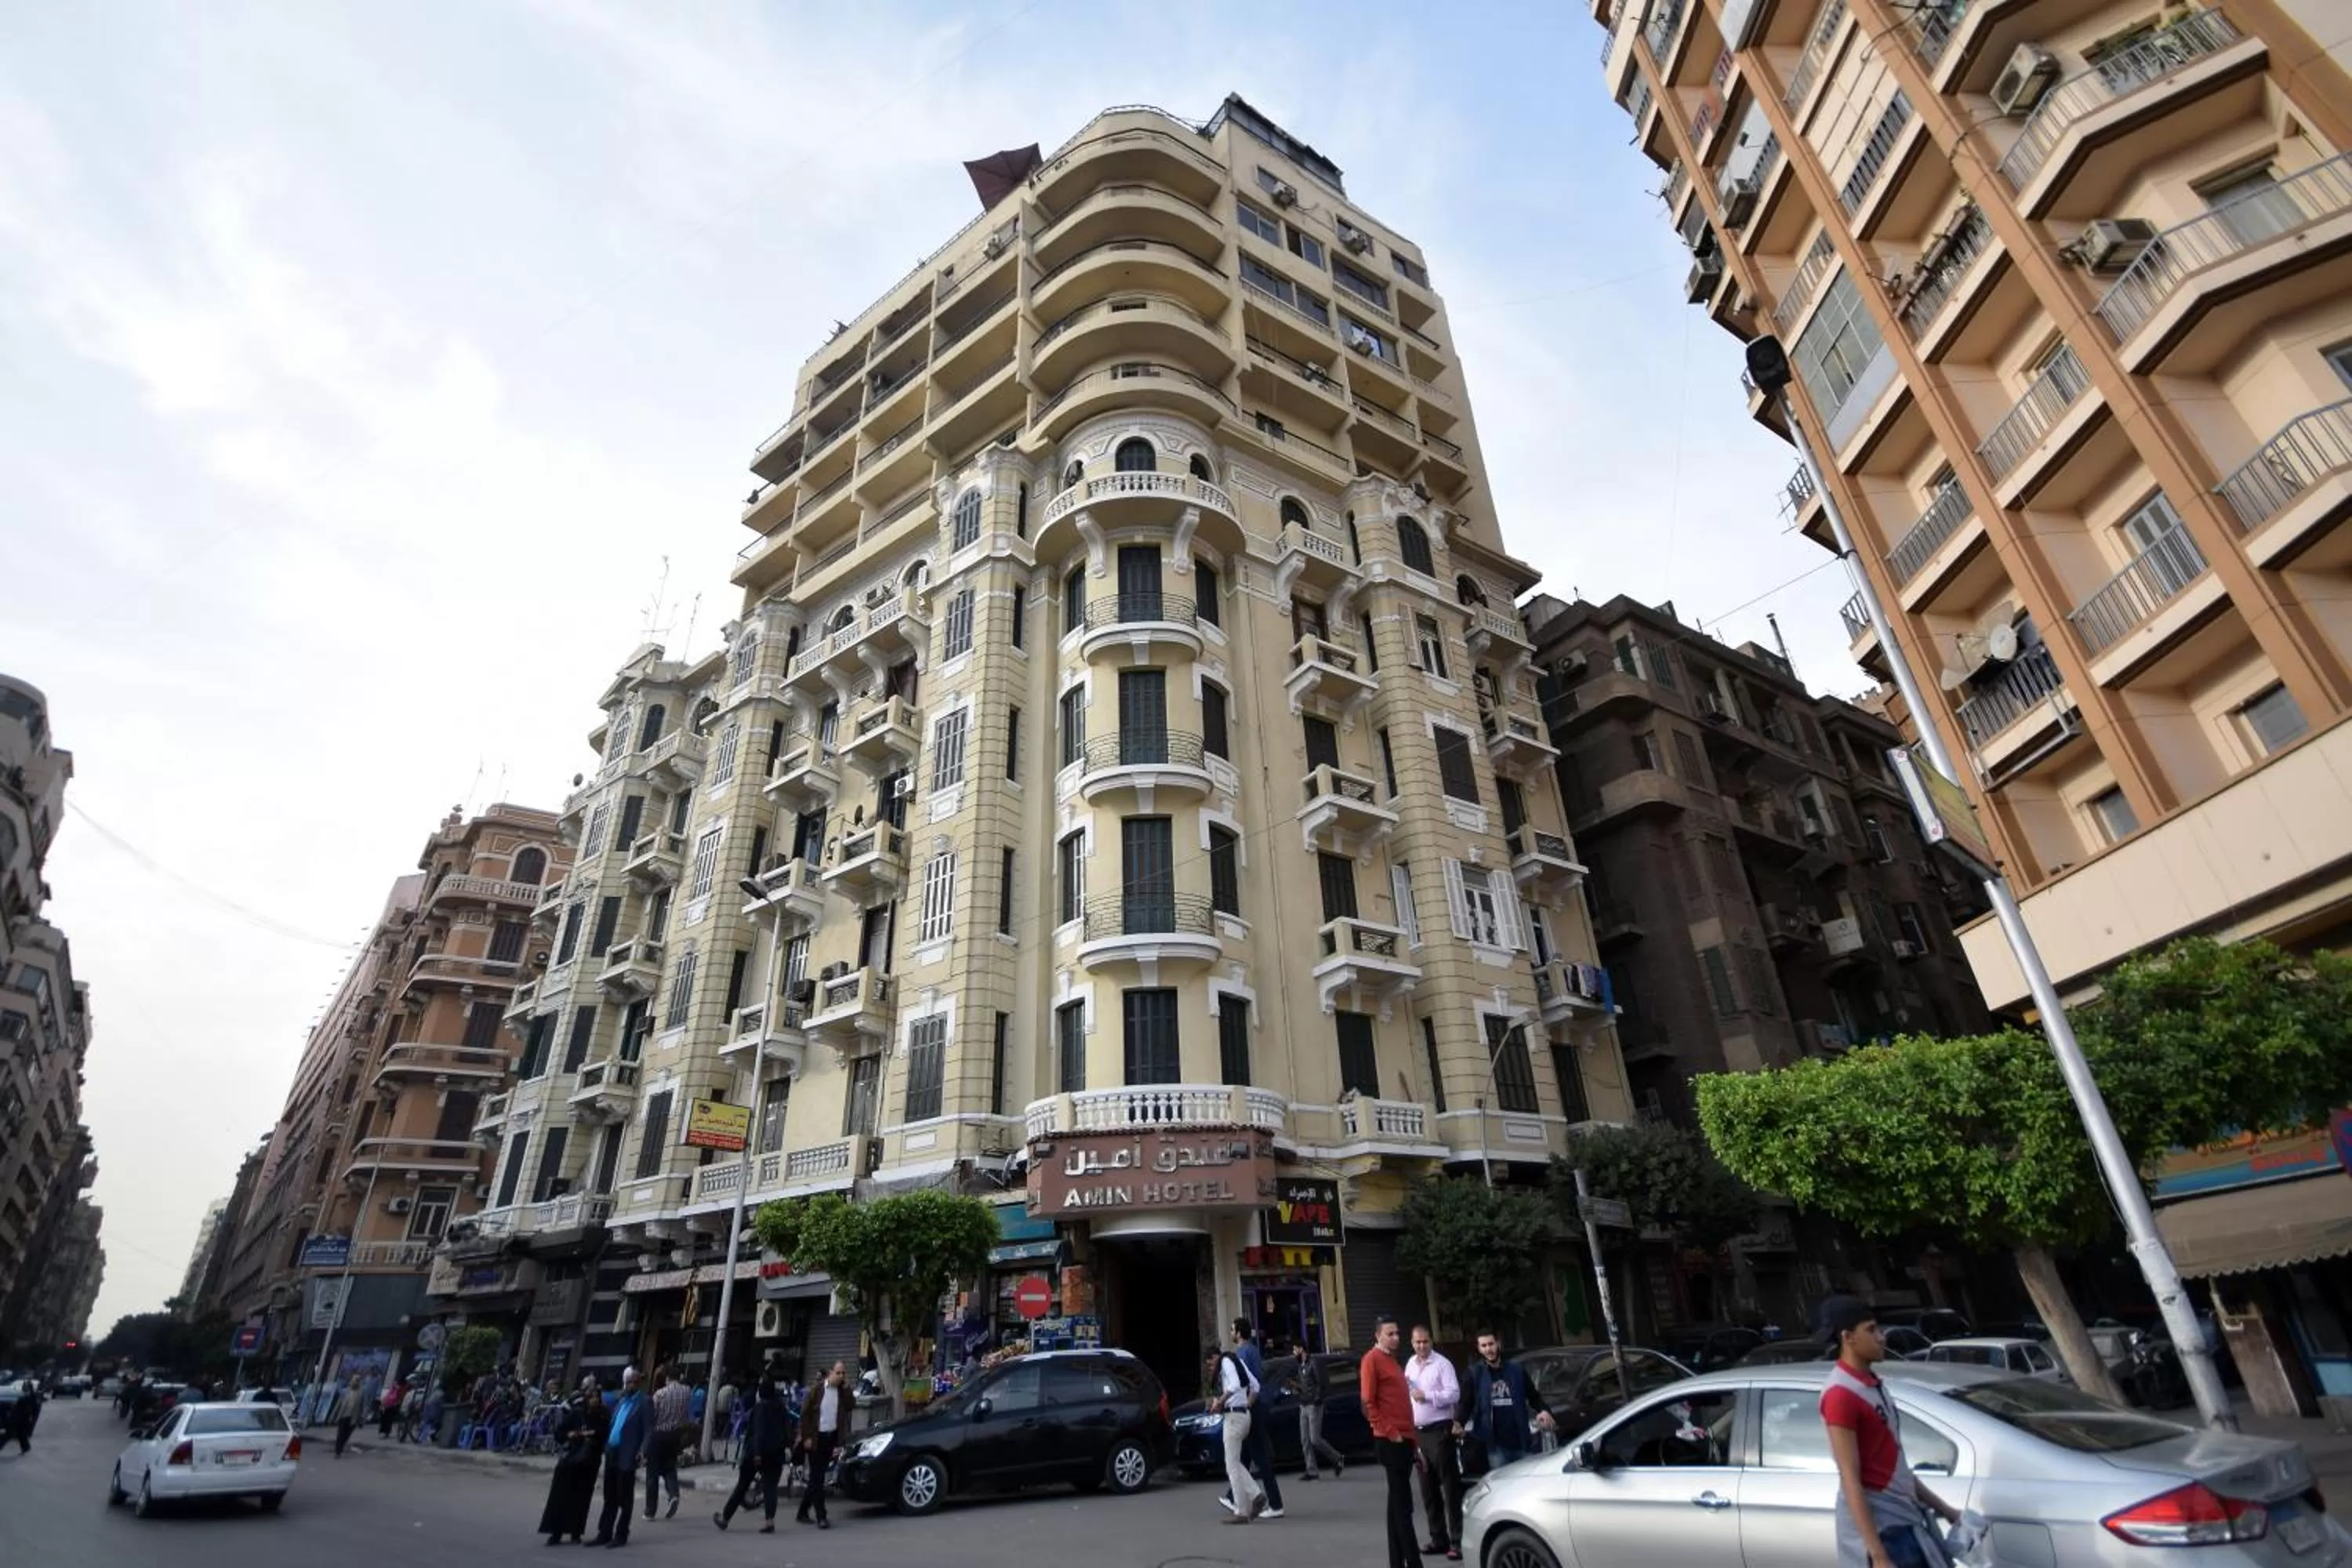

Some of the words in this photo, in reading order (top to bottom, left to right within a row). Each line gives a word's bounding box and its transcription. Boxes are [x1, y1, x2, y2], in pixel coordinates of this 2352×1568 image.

[1063, 1135, 1142, 1176] أمين
[1151, 1136, 1235, 1173] فندق
[1063, 1185, 1134, 1208] AMIN
[1142, 1178, 1235, 1203] HOTEL
[1276, 1200, 1330, 1224] VAPE
